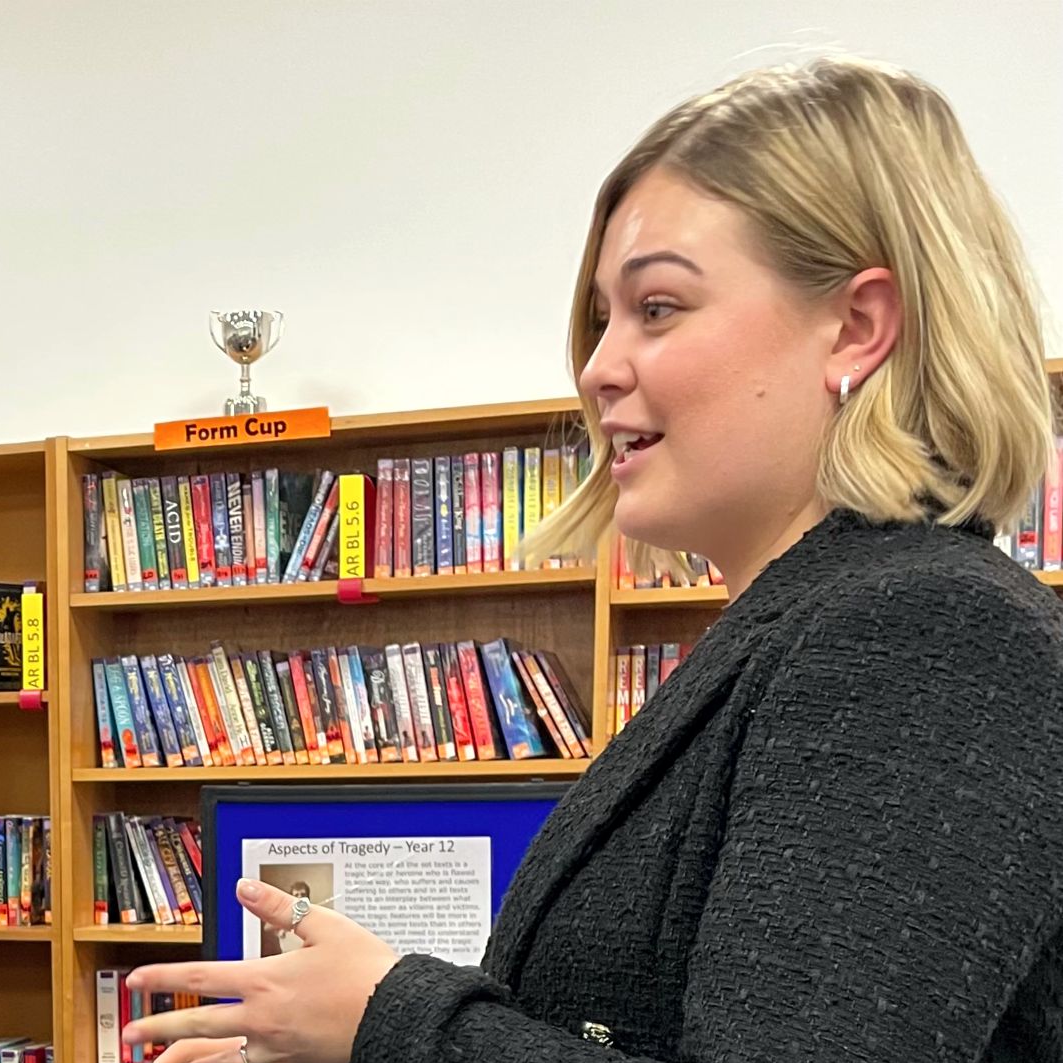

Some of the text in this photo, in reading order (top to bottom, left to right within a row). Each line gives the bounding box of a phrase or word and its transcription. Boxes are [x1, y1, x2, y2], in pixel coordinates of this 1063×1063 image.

[185, 418, 287, 443] Form Cup
[165, 500, 181, 544] ACID
[227, 480, 243, 533] NEVER
[346, 501, 360, 577] AR BL 5.6
[27, 618, 39, 688] AR BL 5.8
[220, 670, 232, 695] David
[113, 694, 128, 726] SPOON
[268, 842, 318, 857] Aspects
[321, 841, 335, 854] of
[339, 841, 391, 856] Tragedy
[405, 840, 435, 853] Year
[439, 840, 455, 853] 12
